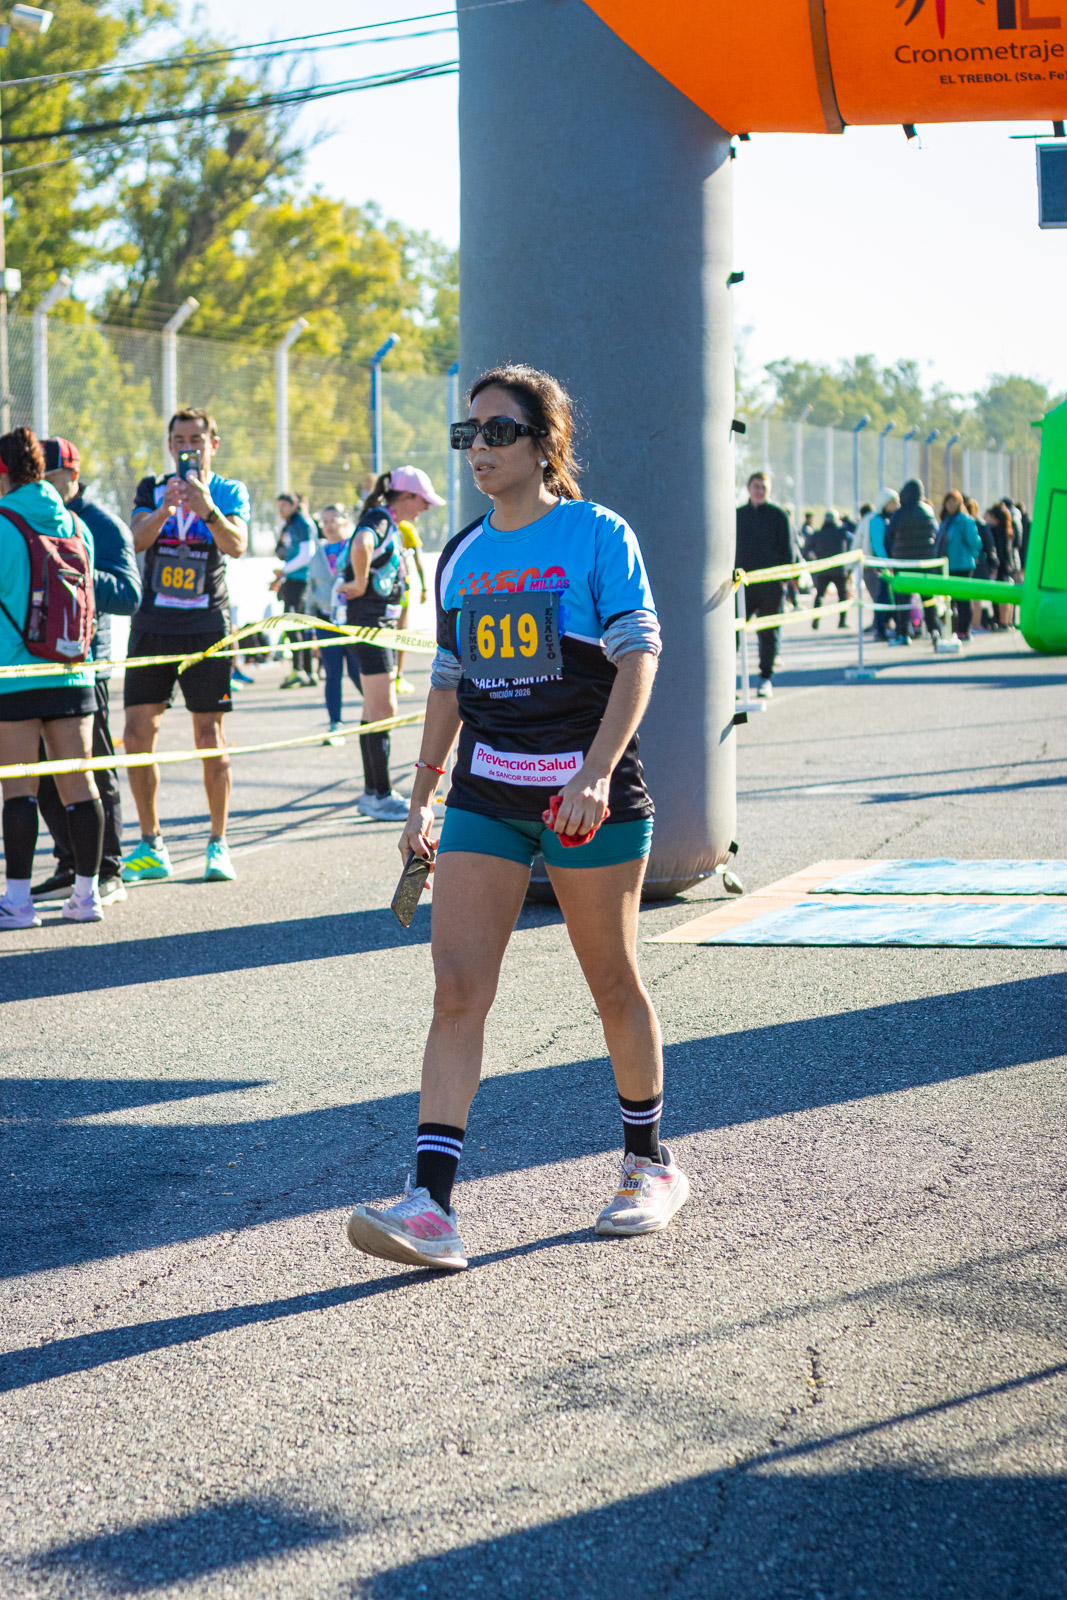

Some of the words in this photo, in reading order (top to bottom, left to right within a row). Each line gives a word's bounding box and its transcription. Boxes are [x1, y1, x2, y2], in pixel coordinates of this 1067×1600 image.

[895, 40, 1064, 64] Cronometraje
[940, 74, 956, 84] EL
[958, 73, 1012, 84] TREBOL
[1015, 71, 1046, 83] (Sta.
[161, 566, 195, 590] 682
[529, 579, 570, 590] MILLAS
[468, 610, 478, 662] TIEMPO
[477, 612, 538, 659] 619
[544, 607, 556, 660] EXACTO
[489, 689, 513, 700] EDICIÓN
[514, 688, 531, 697] 2026
[476, 748, 536, 771] Prevención
[538, 756, 576, 772] Salud
[496, 771, 522, 781] SANCOR
[623, 1180, 639, 1189] 619
